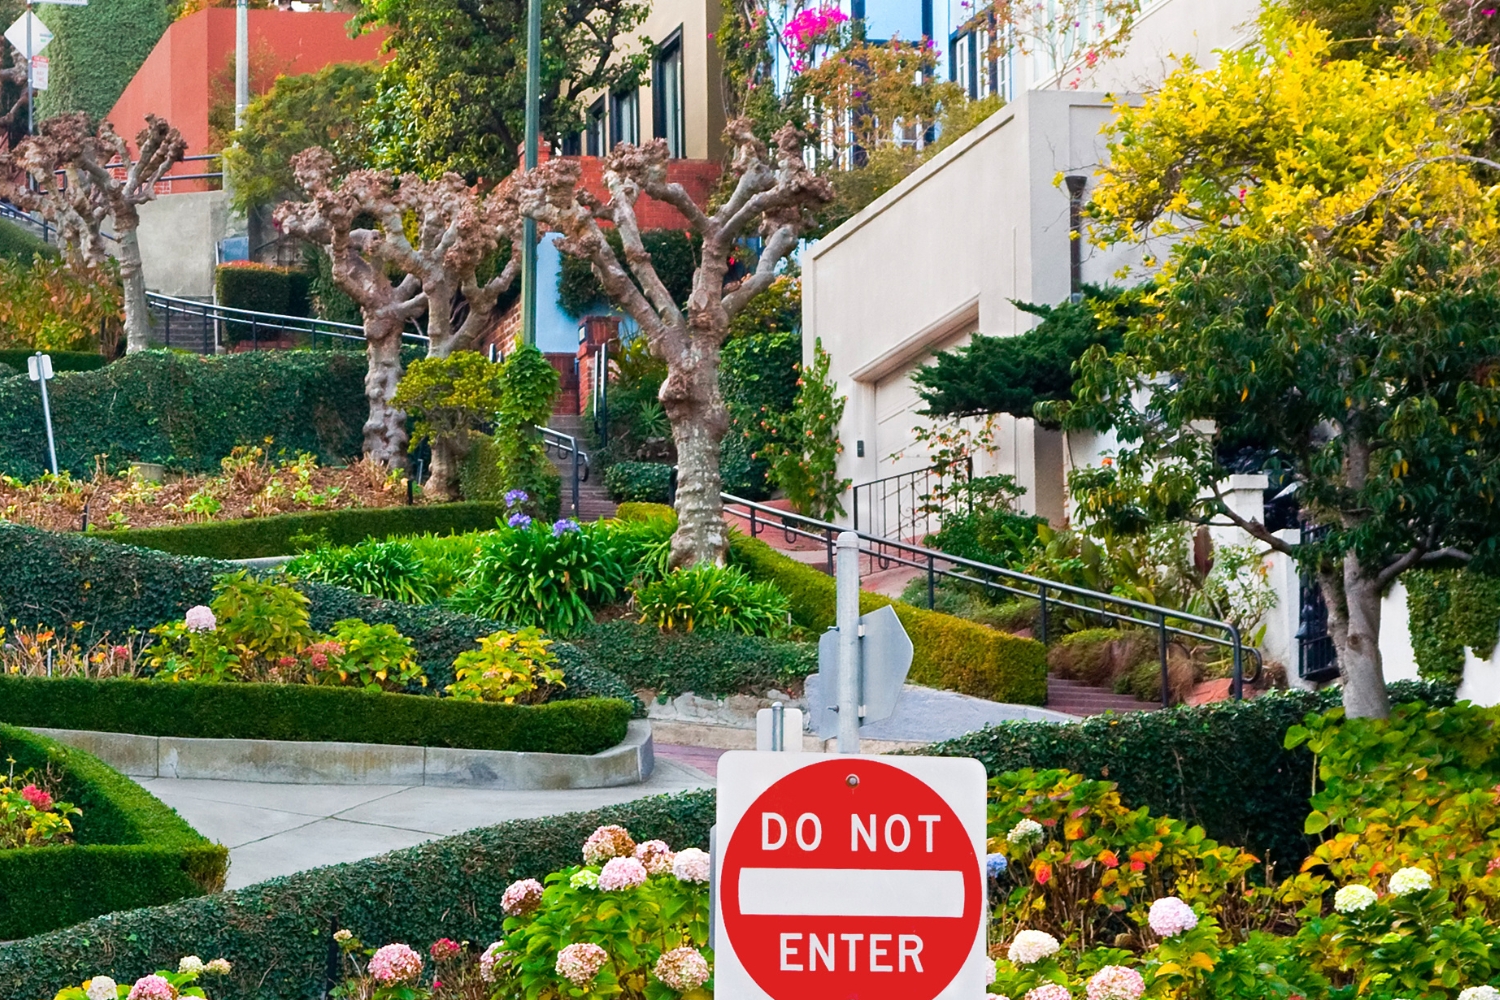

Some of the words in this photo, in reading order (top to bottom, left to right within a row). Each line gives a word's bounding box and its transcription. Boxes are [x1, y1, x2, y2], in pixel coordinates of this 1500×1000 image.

[761, 812, 823, 851] DO
[851, 814, 941, 852] NOT
[780, 933, 924, 973] ENTER
